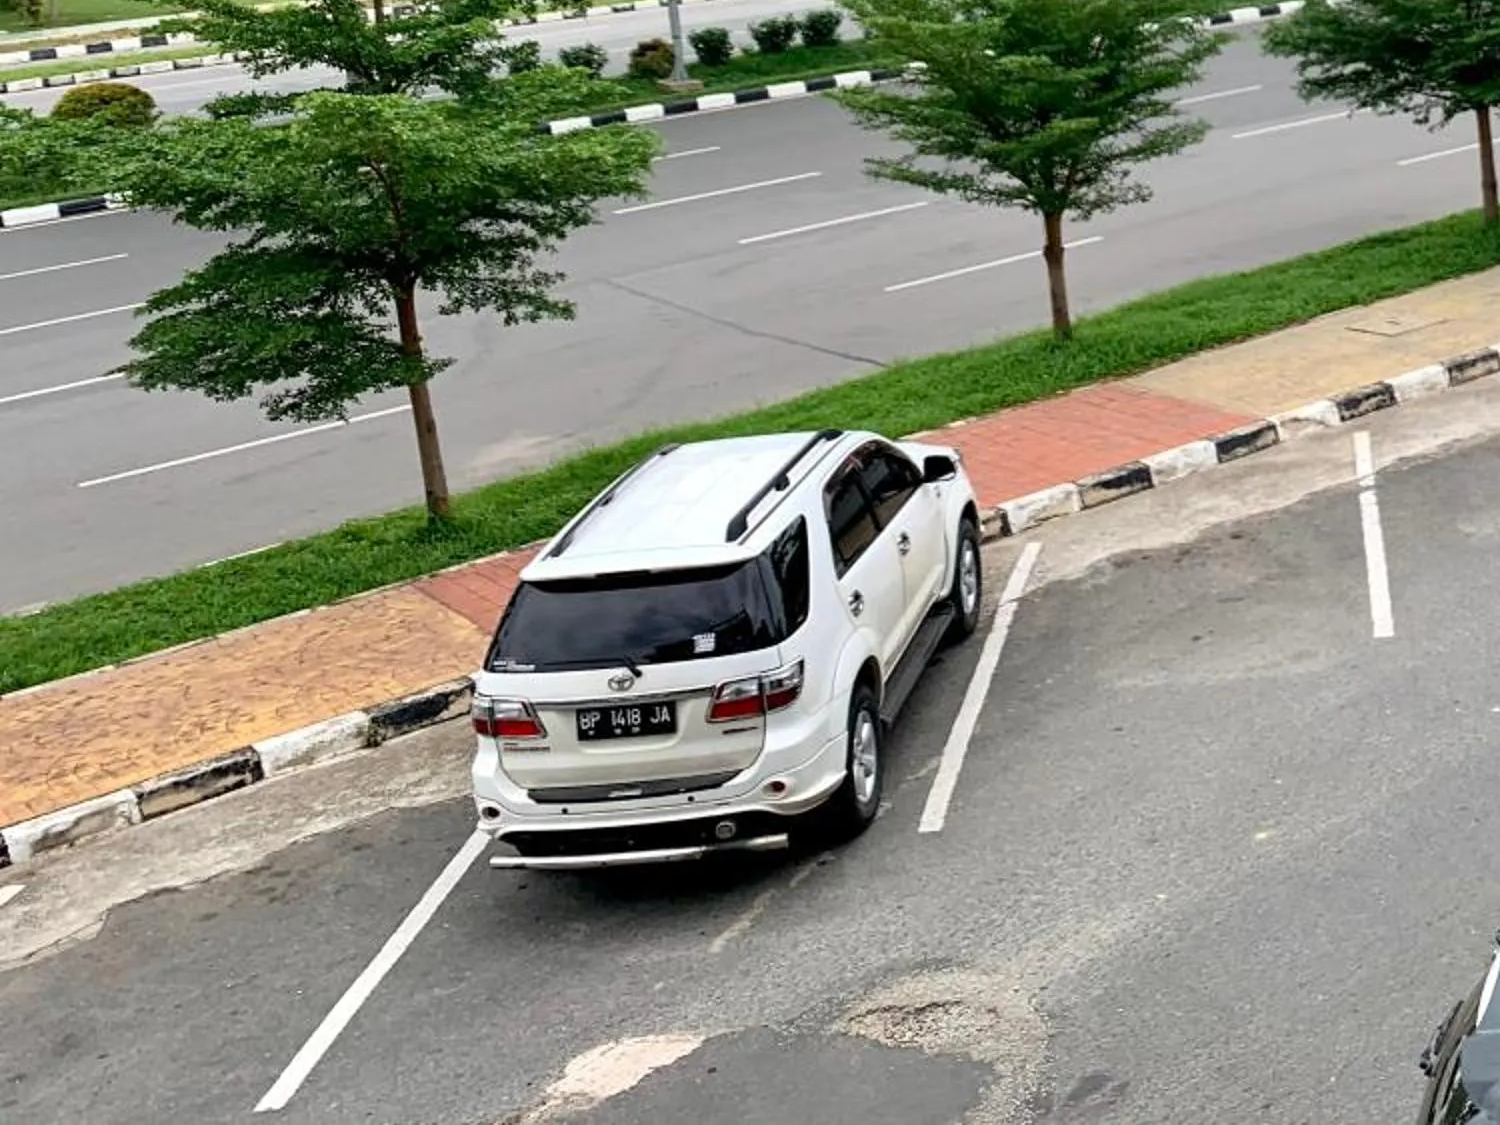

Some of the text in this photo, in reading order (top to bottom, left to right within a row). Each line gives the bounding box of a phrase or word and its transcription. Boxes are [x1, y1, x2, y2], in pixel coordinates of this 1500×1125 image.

[580, 705, 671, 730] BP 1418 JA
